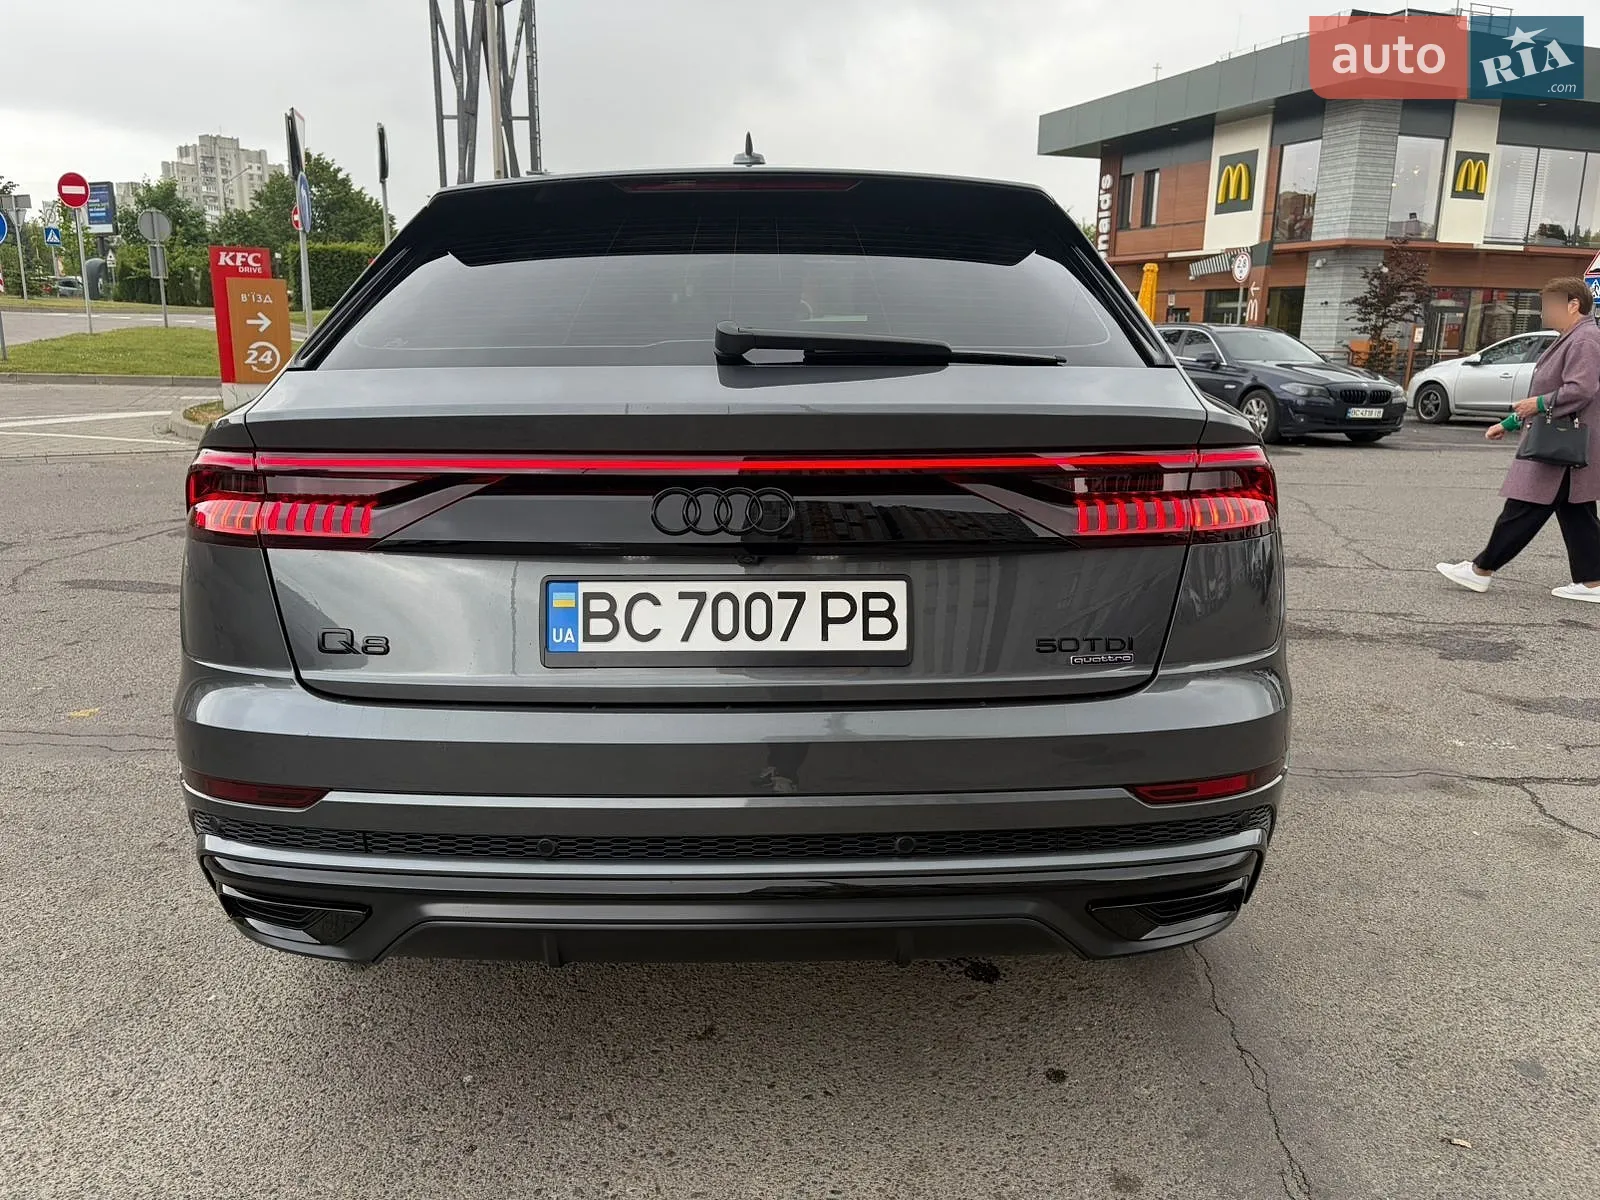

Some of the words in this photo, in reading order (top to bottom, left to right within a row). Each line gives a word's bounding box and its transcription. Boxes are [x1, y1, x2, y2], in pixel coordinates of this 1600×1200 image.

[217, 251, 262, 267] KFC
[238, 266, 263, 274] DRIVE
[244, 349, 273, 365] 24
[582, 591, 661, 643] BC
[677, 591, 806, 642] 7007
[820, 591, 899, 642] PB
[317, 627, 390, 656] Q8
[552, 628, 576, 644] UA
[1073, 655, 1132, 664] quattro
